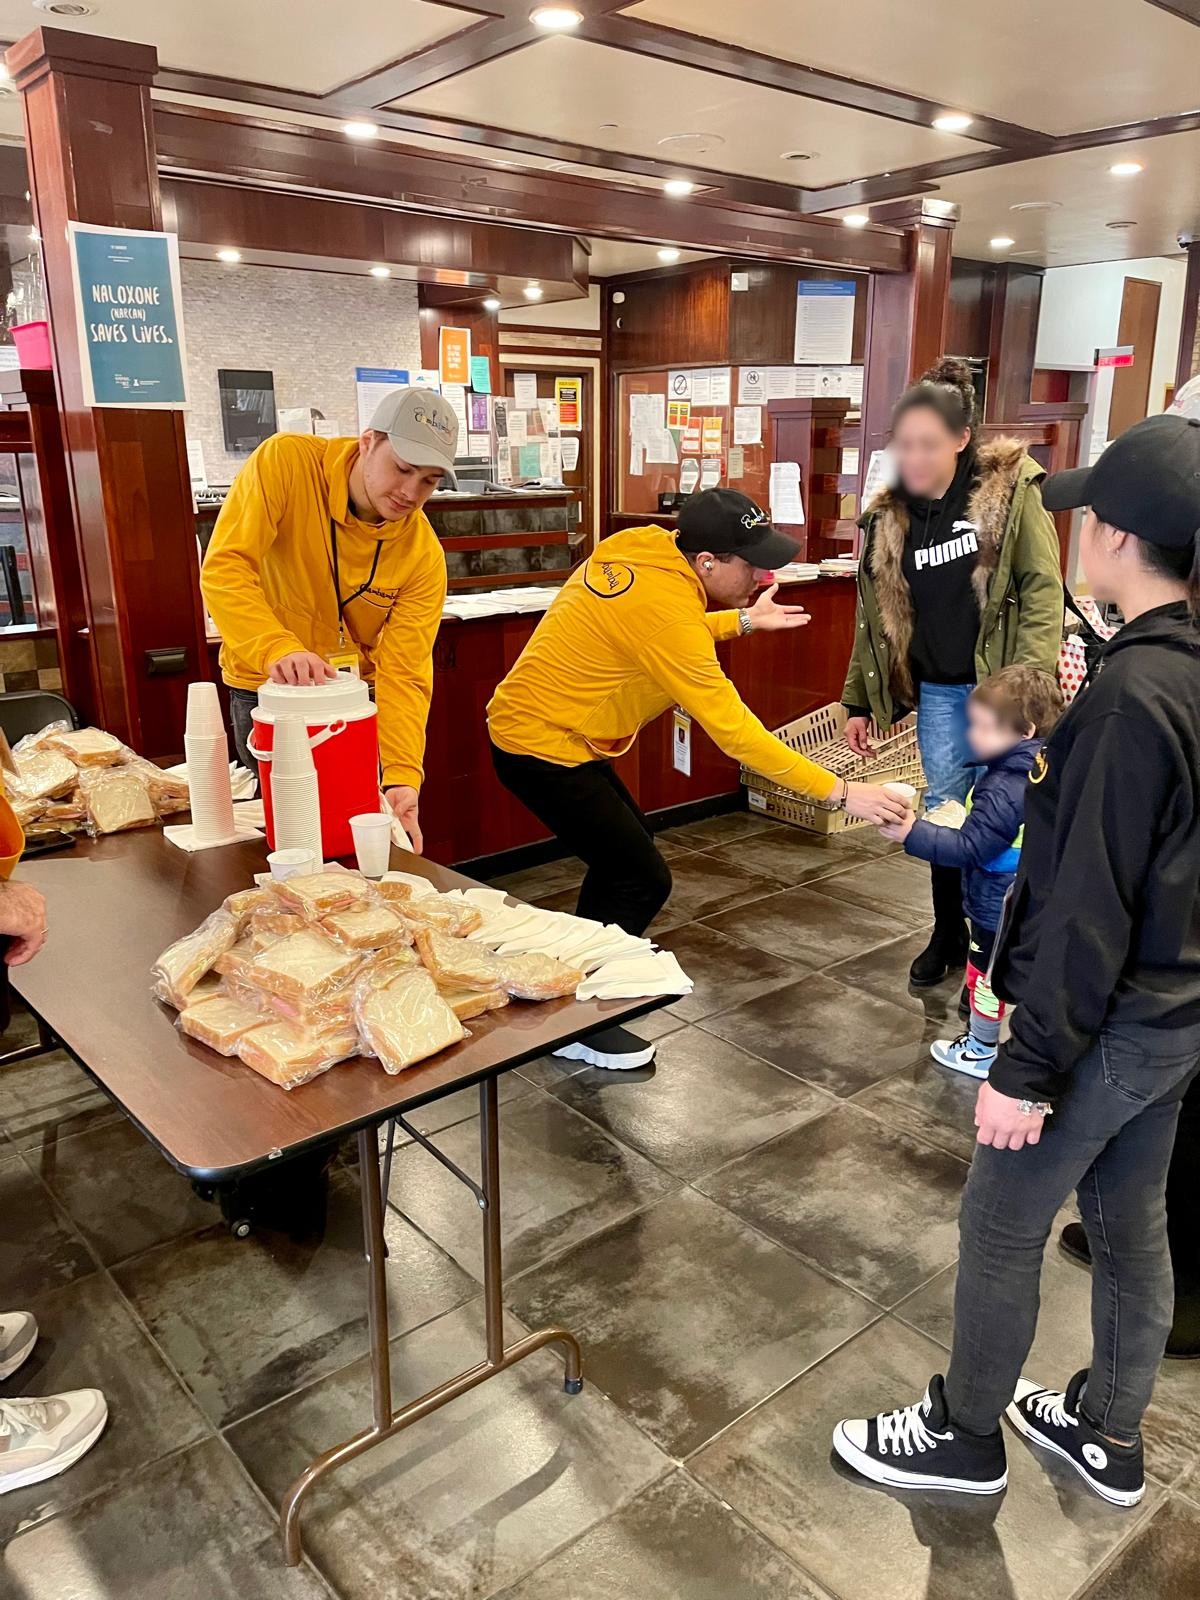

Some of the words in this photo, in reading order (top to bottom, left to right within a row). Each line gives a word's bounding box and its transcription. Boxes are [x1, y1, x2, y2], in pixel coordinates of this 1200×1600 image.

[92, 284, 160, 305] NALOXONE
[110, 308, 146, 321] (NARCAN)
[91, 323, 128, 343] SAVES
[914, 532, 979, 571] PUMA
